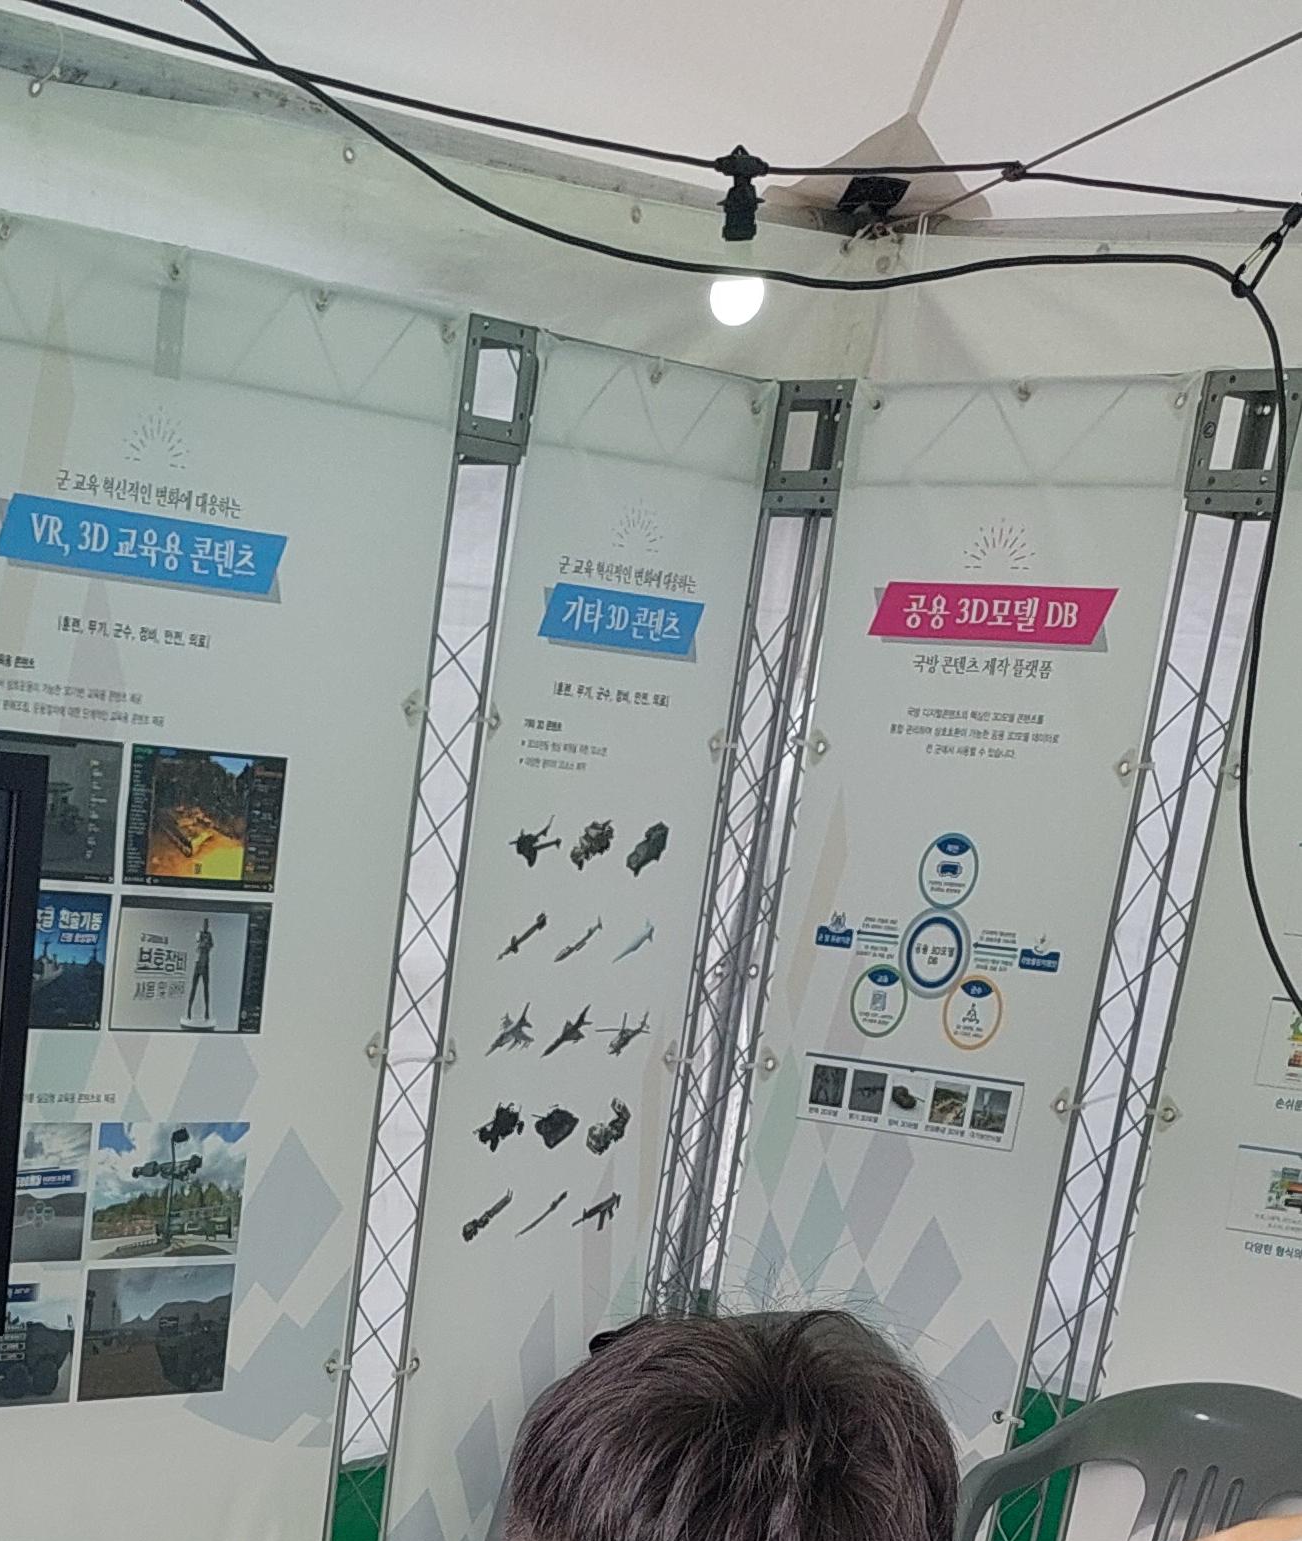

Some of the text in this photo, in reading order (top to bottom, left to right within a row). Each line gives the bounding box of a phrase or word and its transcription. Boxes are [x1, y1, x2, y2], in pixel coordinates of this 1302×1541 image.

[56, 469, 243, 519] 군 교육 혁신적인 변화에 대응하는
[30, 511, 258, 579] VR, 3D 교육용 콘텐츠
[559, 555, 698, 594] 군 교육 혁신적인 변화에 대응하는
[561, 595, 681, 642] 기타 3D 콘텐츠
[903, 593, 1079, 632] 공용 3D모델 DB
[912, 654, 1053, 679] 국방 콘텐츠 제작 플랫폼
